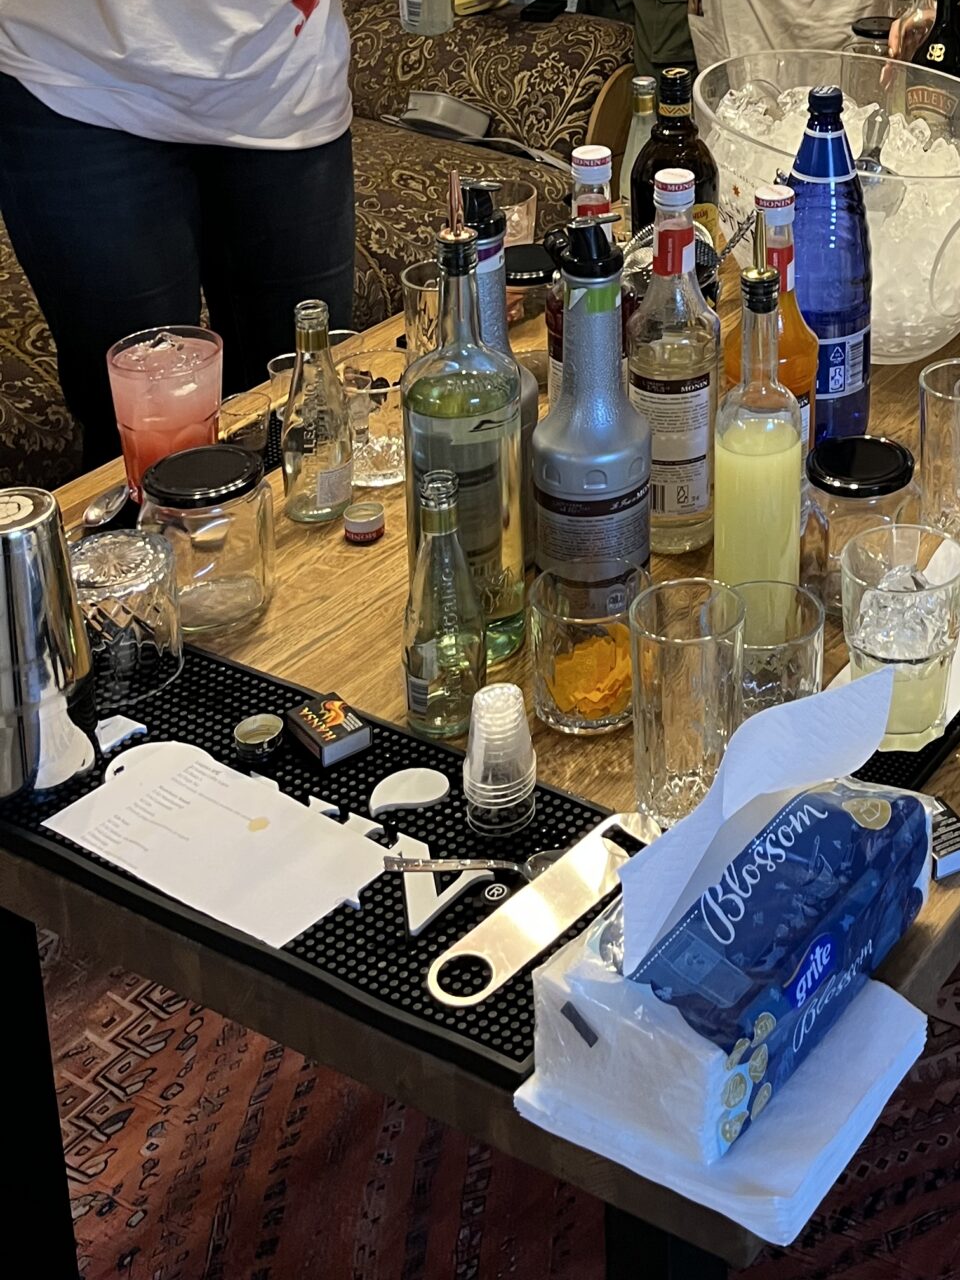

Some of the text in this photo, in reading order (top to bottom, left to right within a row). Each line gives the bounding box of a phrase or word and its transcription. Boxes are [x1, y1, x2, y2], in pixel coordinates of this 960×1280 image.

[906, 88, 953, 111] BAILEYS
[758, 197, 793, 210] MONIN
[681, 378, 709, 394] MONIN
[299, 706, 337, 741] HANSA
[701, 803, 829, 946] Blossom
[796, 942, 831, 1010] grite
[792, 938, 873, 1053] Blossom
